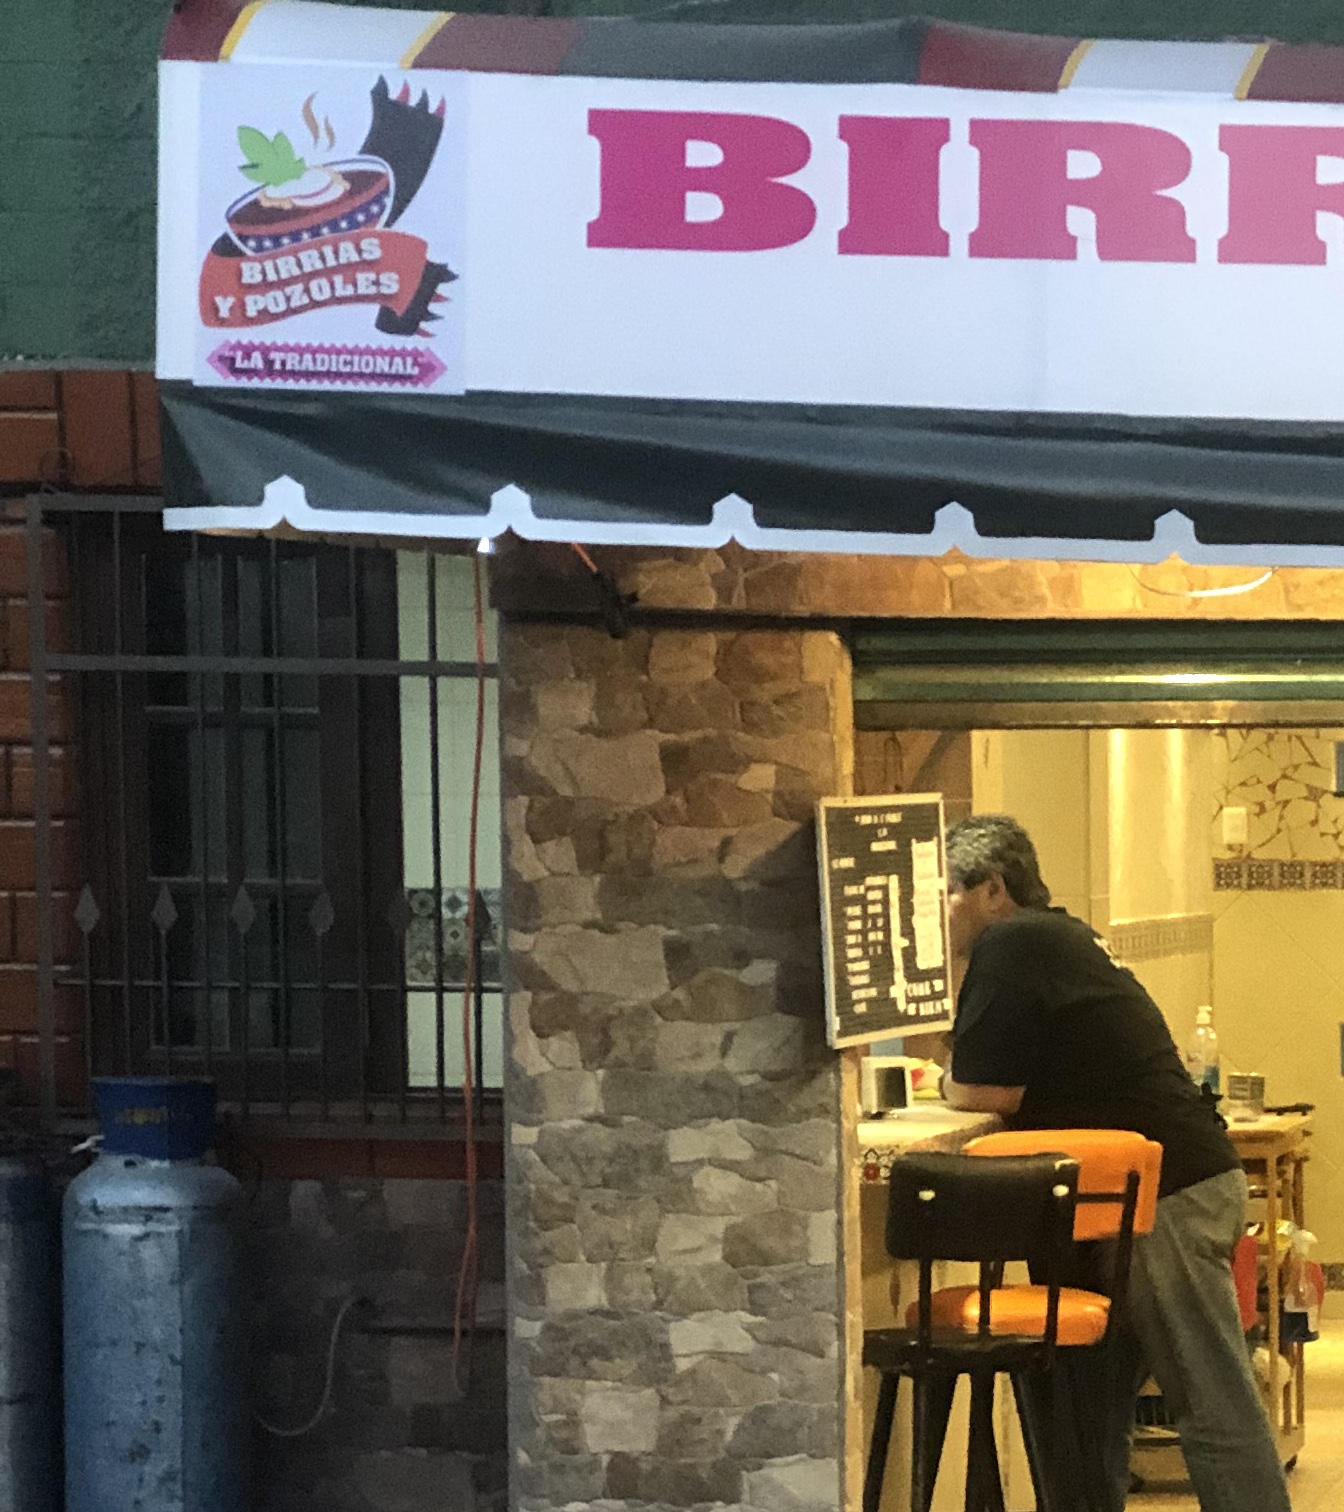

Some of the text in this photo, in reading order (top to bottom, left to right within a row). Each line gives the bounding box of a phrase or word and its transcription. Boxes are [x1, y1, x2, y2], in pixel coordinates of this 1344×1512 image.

[240, 237, 383, 285] BIRRIAS
[214, 271, 400, 319] Y POZOLES
